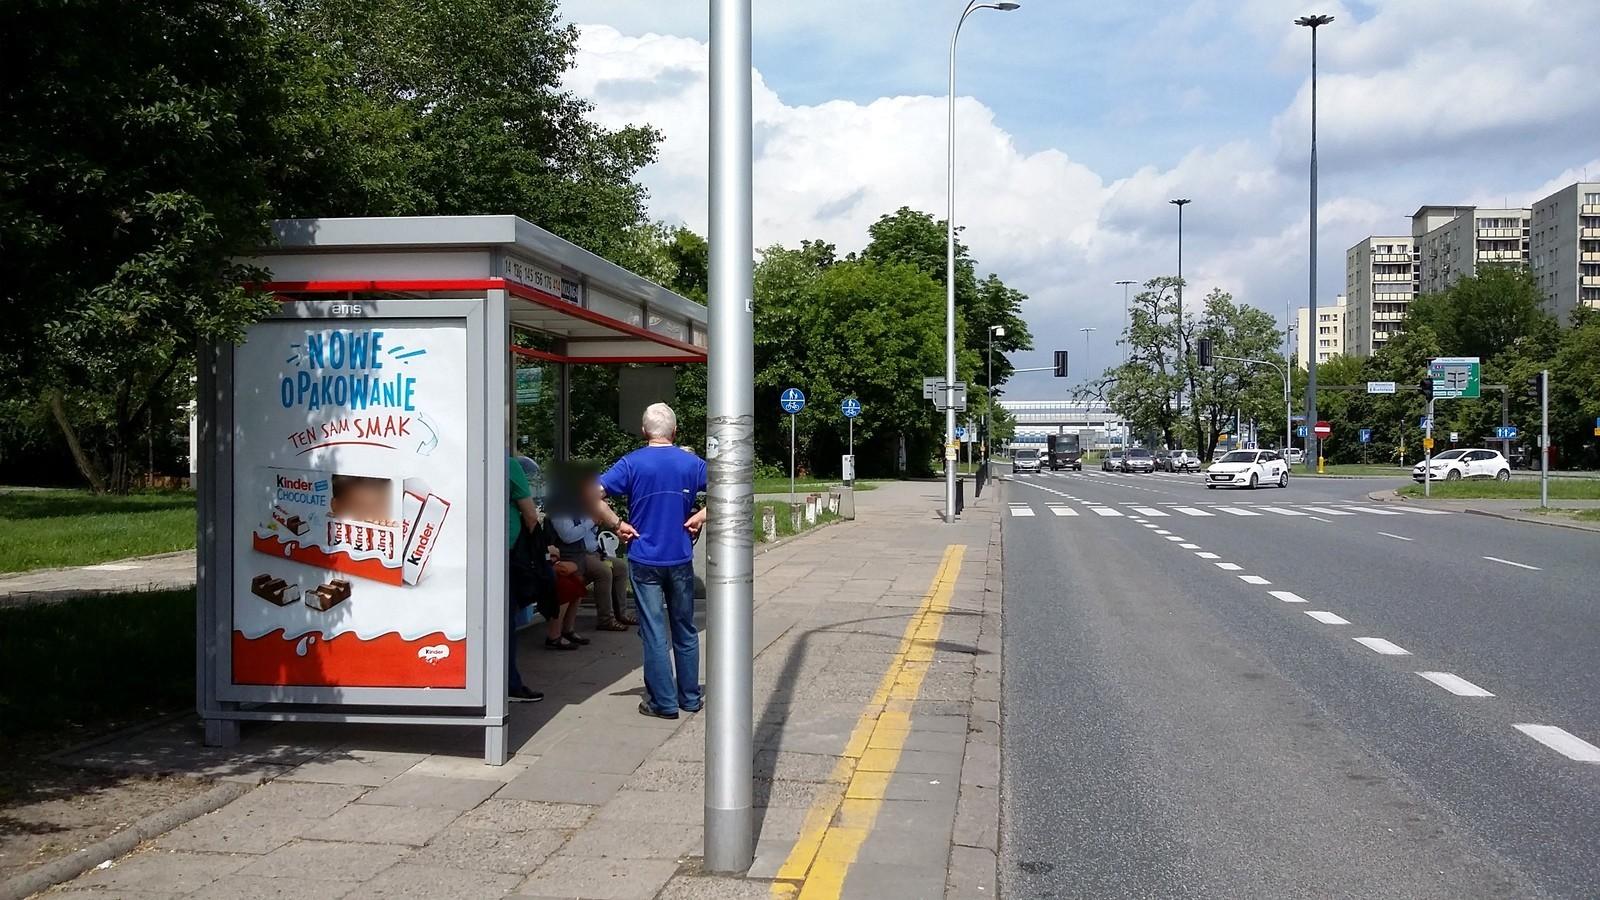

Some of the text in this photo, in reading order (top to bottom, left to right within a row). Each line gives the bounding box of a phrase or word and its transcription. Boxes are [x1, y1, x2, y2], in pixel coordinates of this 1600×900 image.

[524, 267, 533, 282] 145
[332, 303, 361, 314] ams
[308, 331, 384, 370] NOWE
[281, 371, 417, 412] OPAKOWANIE
[287, 416, 411, 449] TEN SAM SMAK
[276, 474, 313, 491] Kinder
[277, 488, 327, 507] CHOCOLATE
[407, 522, 434, 566] Kinder
